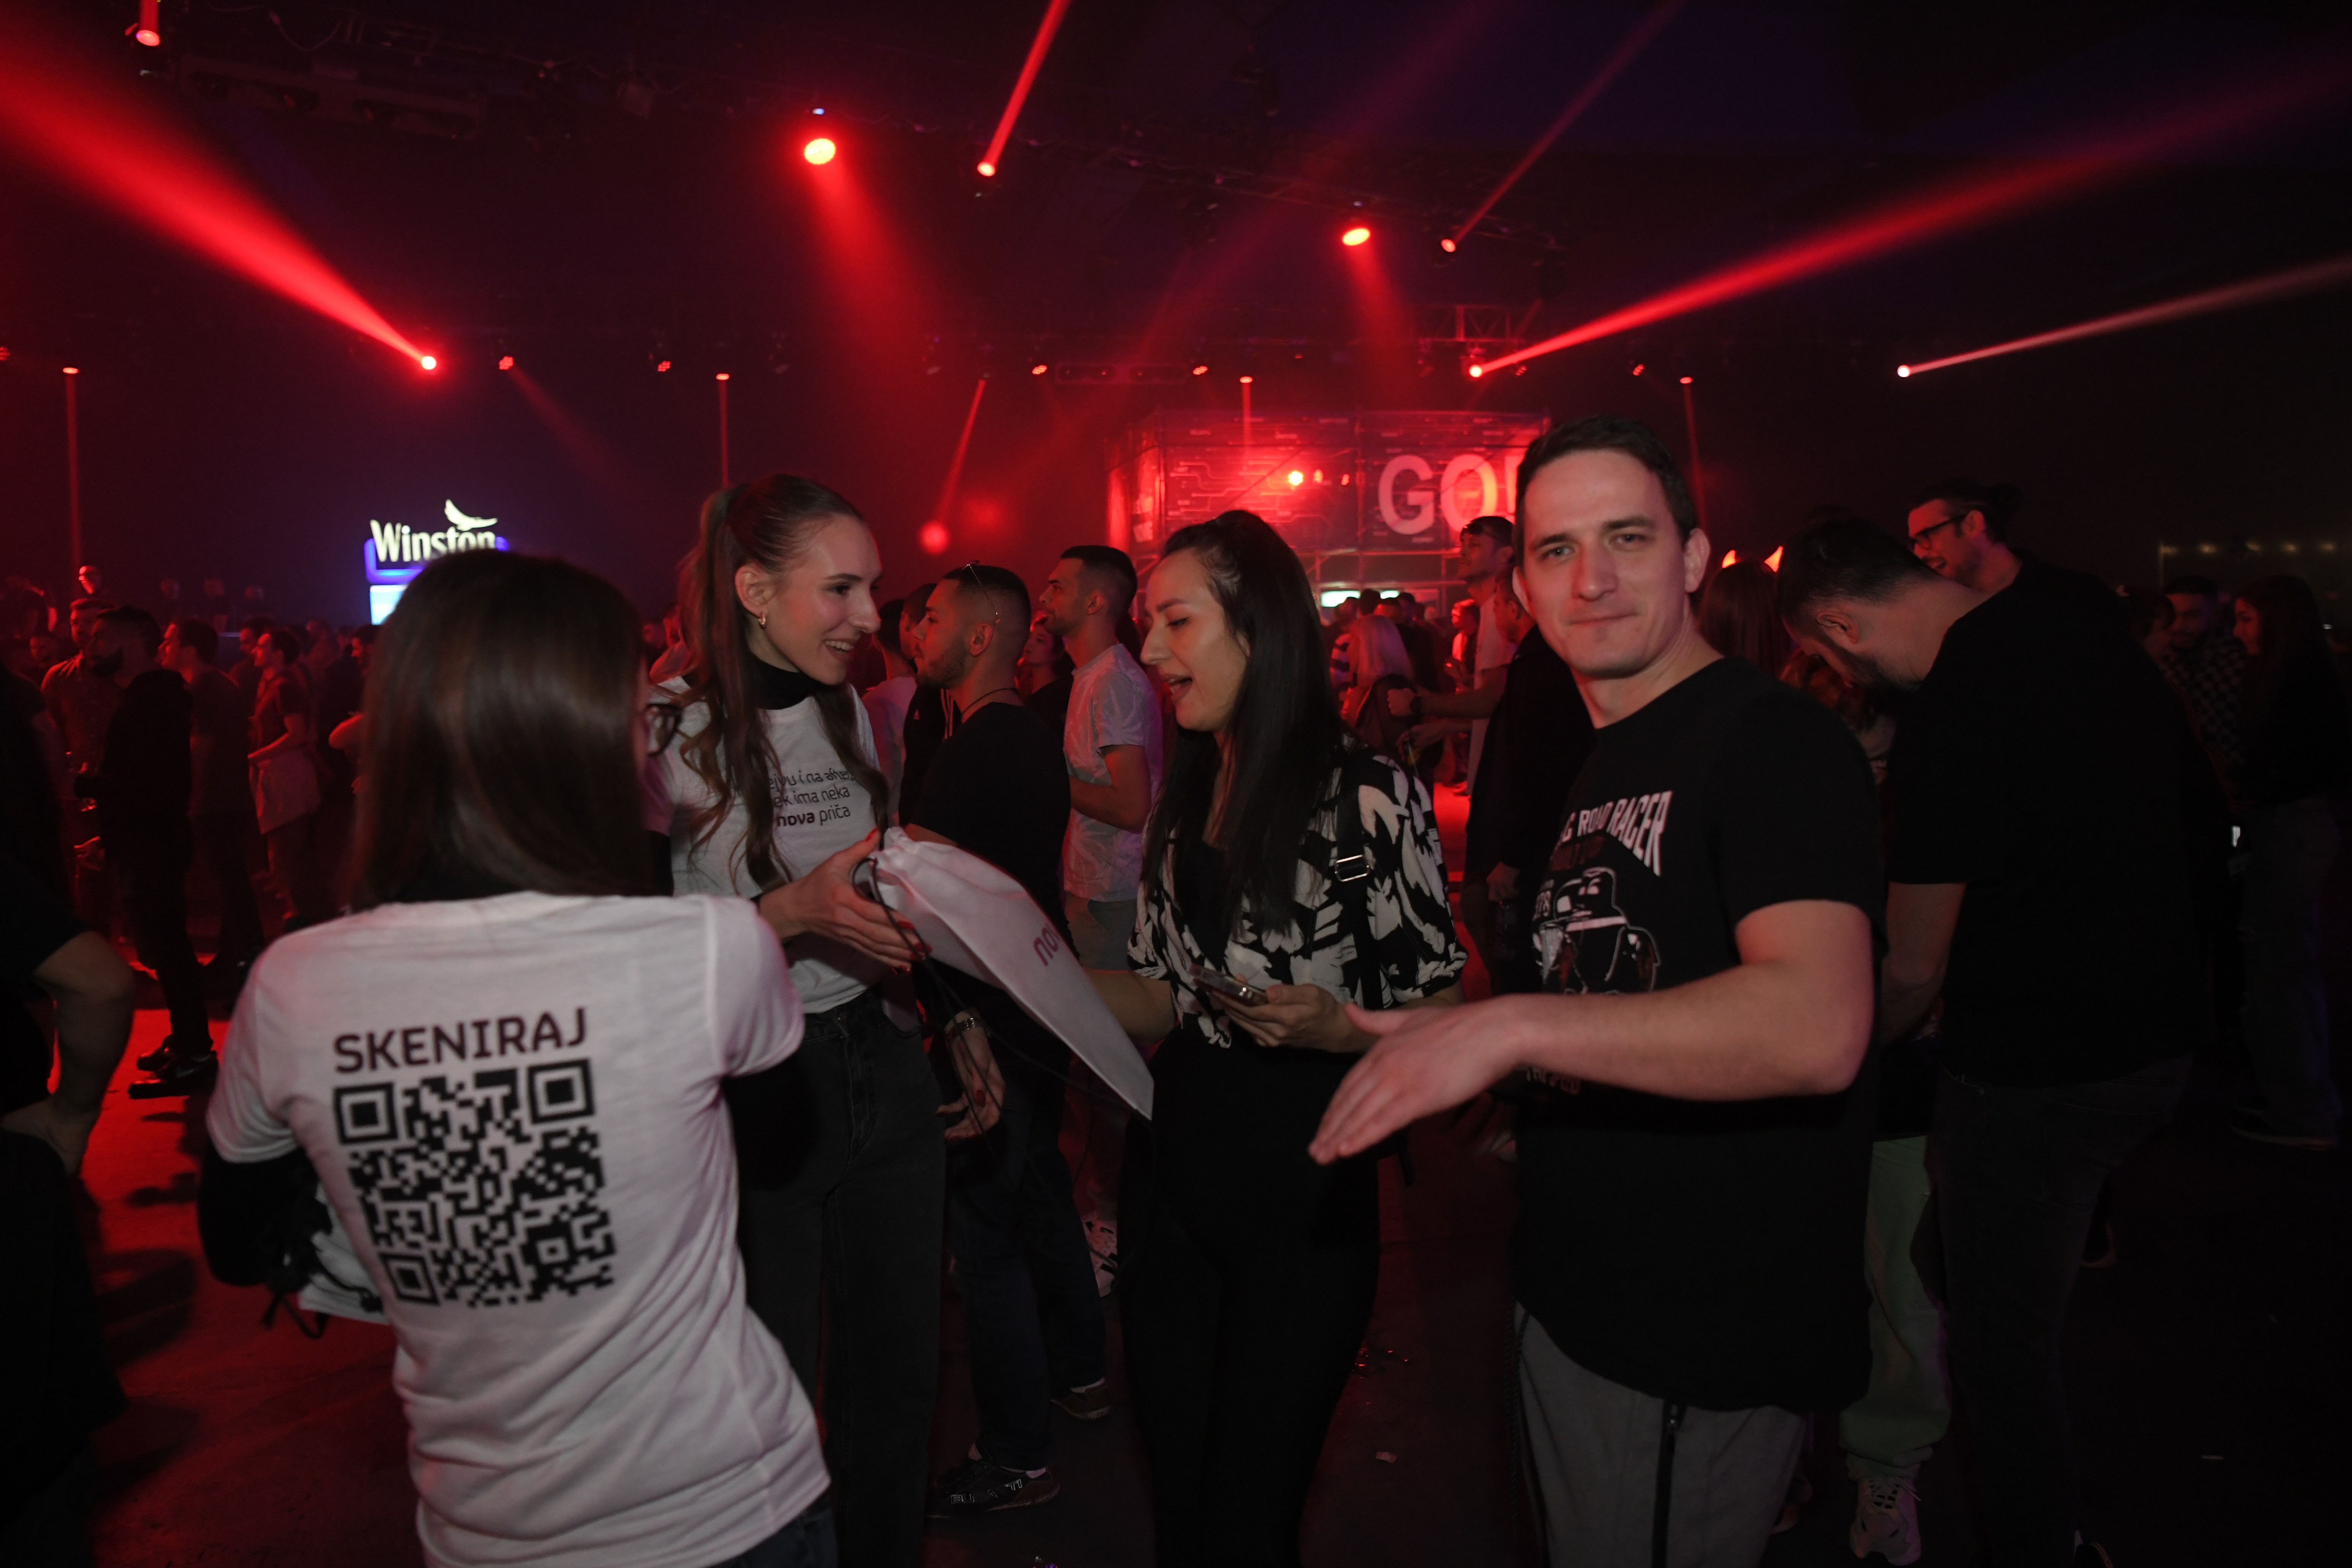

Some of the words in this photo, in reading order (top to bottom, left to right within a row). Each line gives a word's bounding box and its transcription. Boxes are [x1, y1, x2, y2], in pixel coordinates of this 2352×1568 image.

[370, 519, 495, 562] Winston
[769, 773, 797, 792] ejvu
[799, 770, 804, 784] i
[806, 773, 823, 783] na
[774, 796, 792, 808] ek
[793, 791, 819, 804] ima
[821, 784, 850, 801] neka
[776, 812, 815, 827] nova
[819, 803, 850, 826] priča
[1606, 790, 1674, 877] RACER
[333, 1006, 586, 1074] SKENIRAJ
